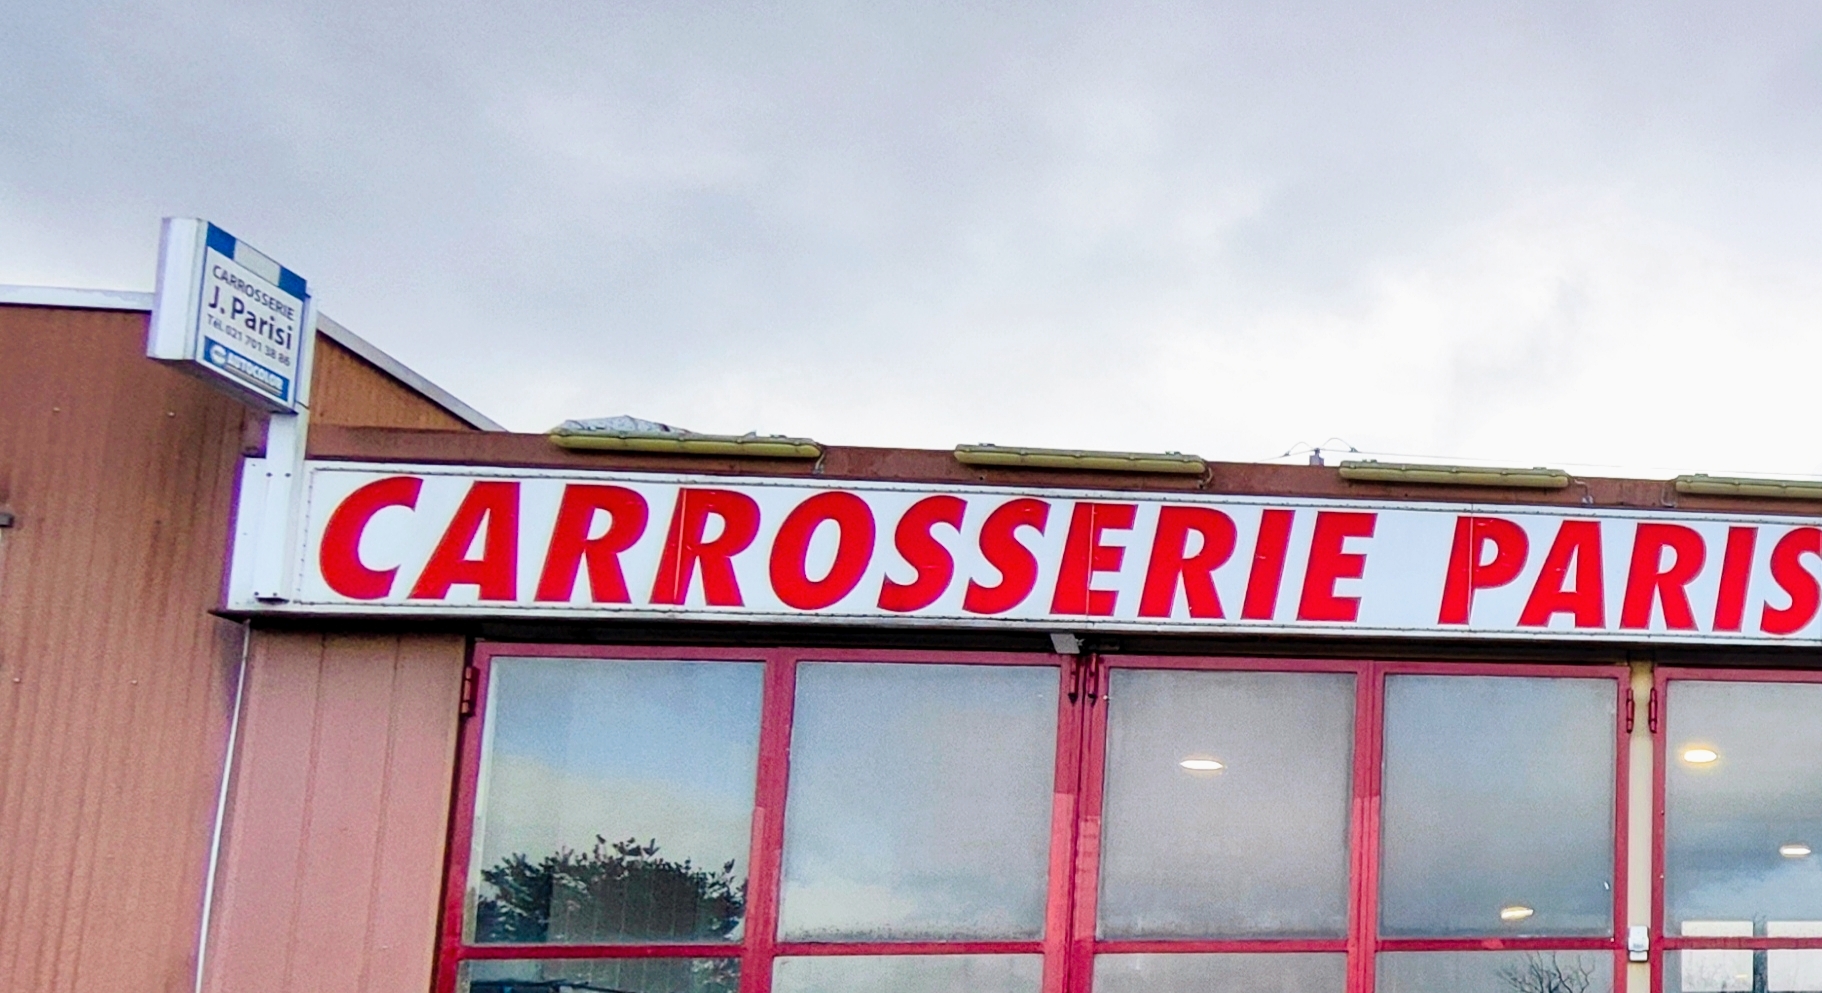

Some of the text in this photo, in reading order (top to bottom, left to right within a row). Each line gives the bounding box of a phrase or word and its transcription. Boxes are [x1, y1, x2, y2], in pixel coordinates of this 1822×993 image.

[208, 286, 293, 350] J. Parisi
[212, 265, 295, 321] CARROSSERIE
[226, 324, 242, 341] 021
[246, 335, 262, 351] 701
[265, 345, 277, 359] 38
[278, 353, 291, 367] 86
[320, 476, 1375, 615] CARROSSERIE
